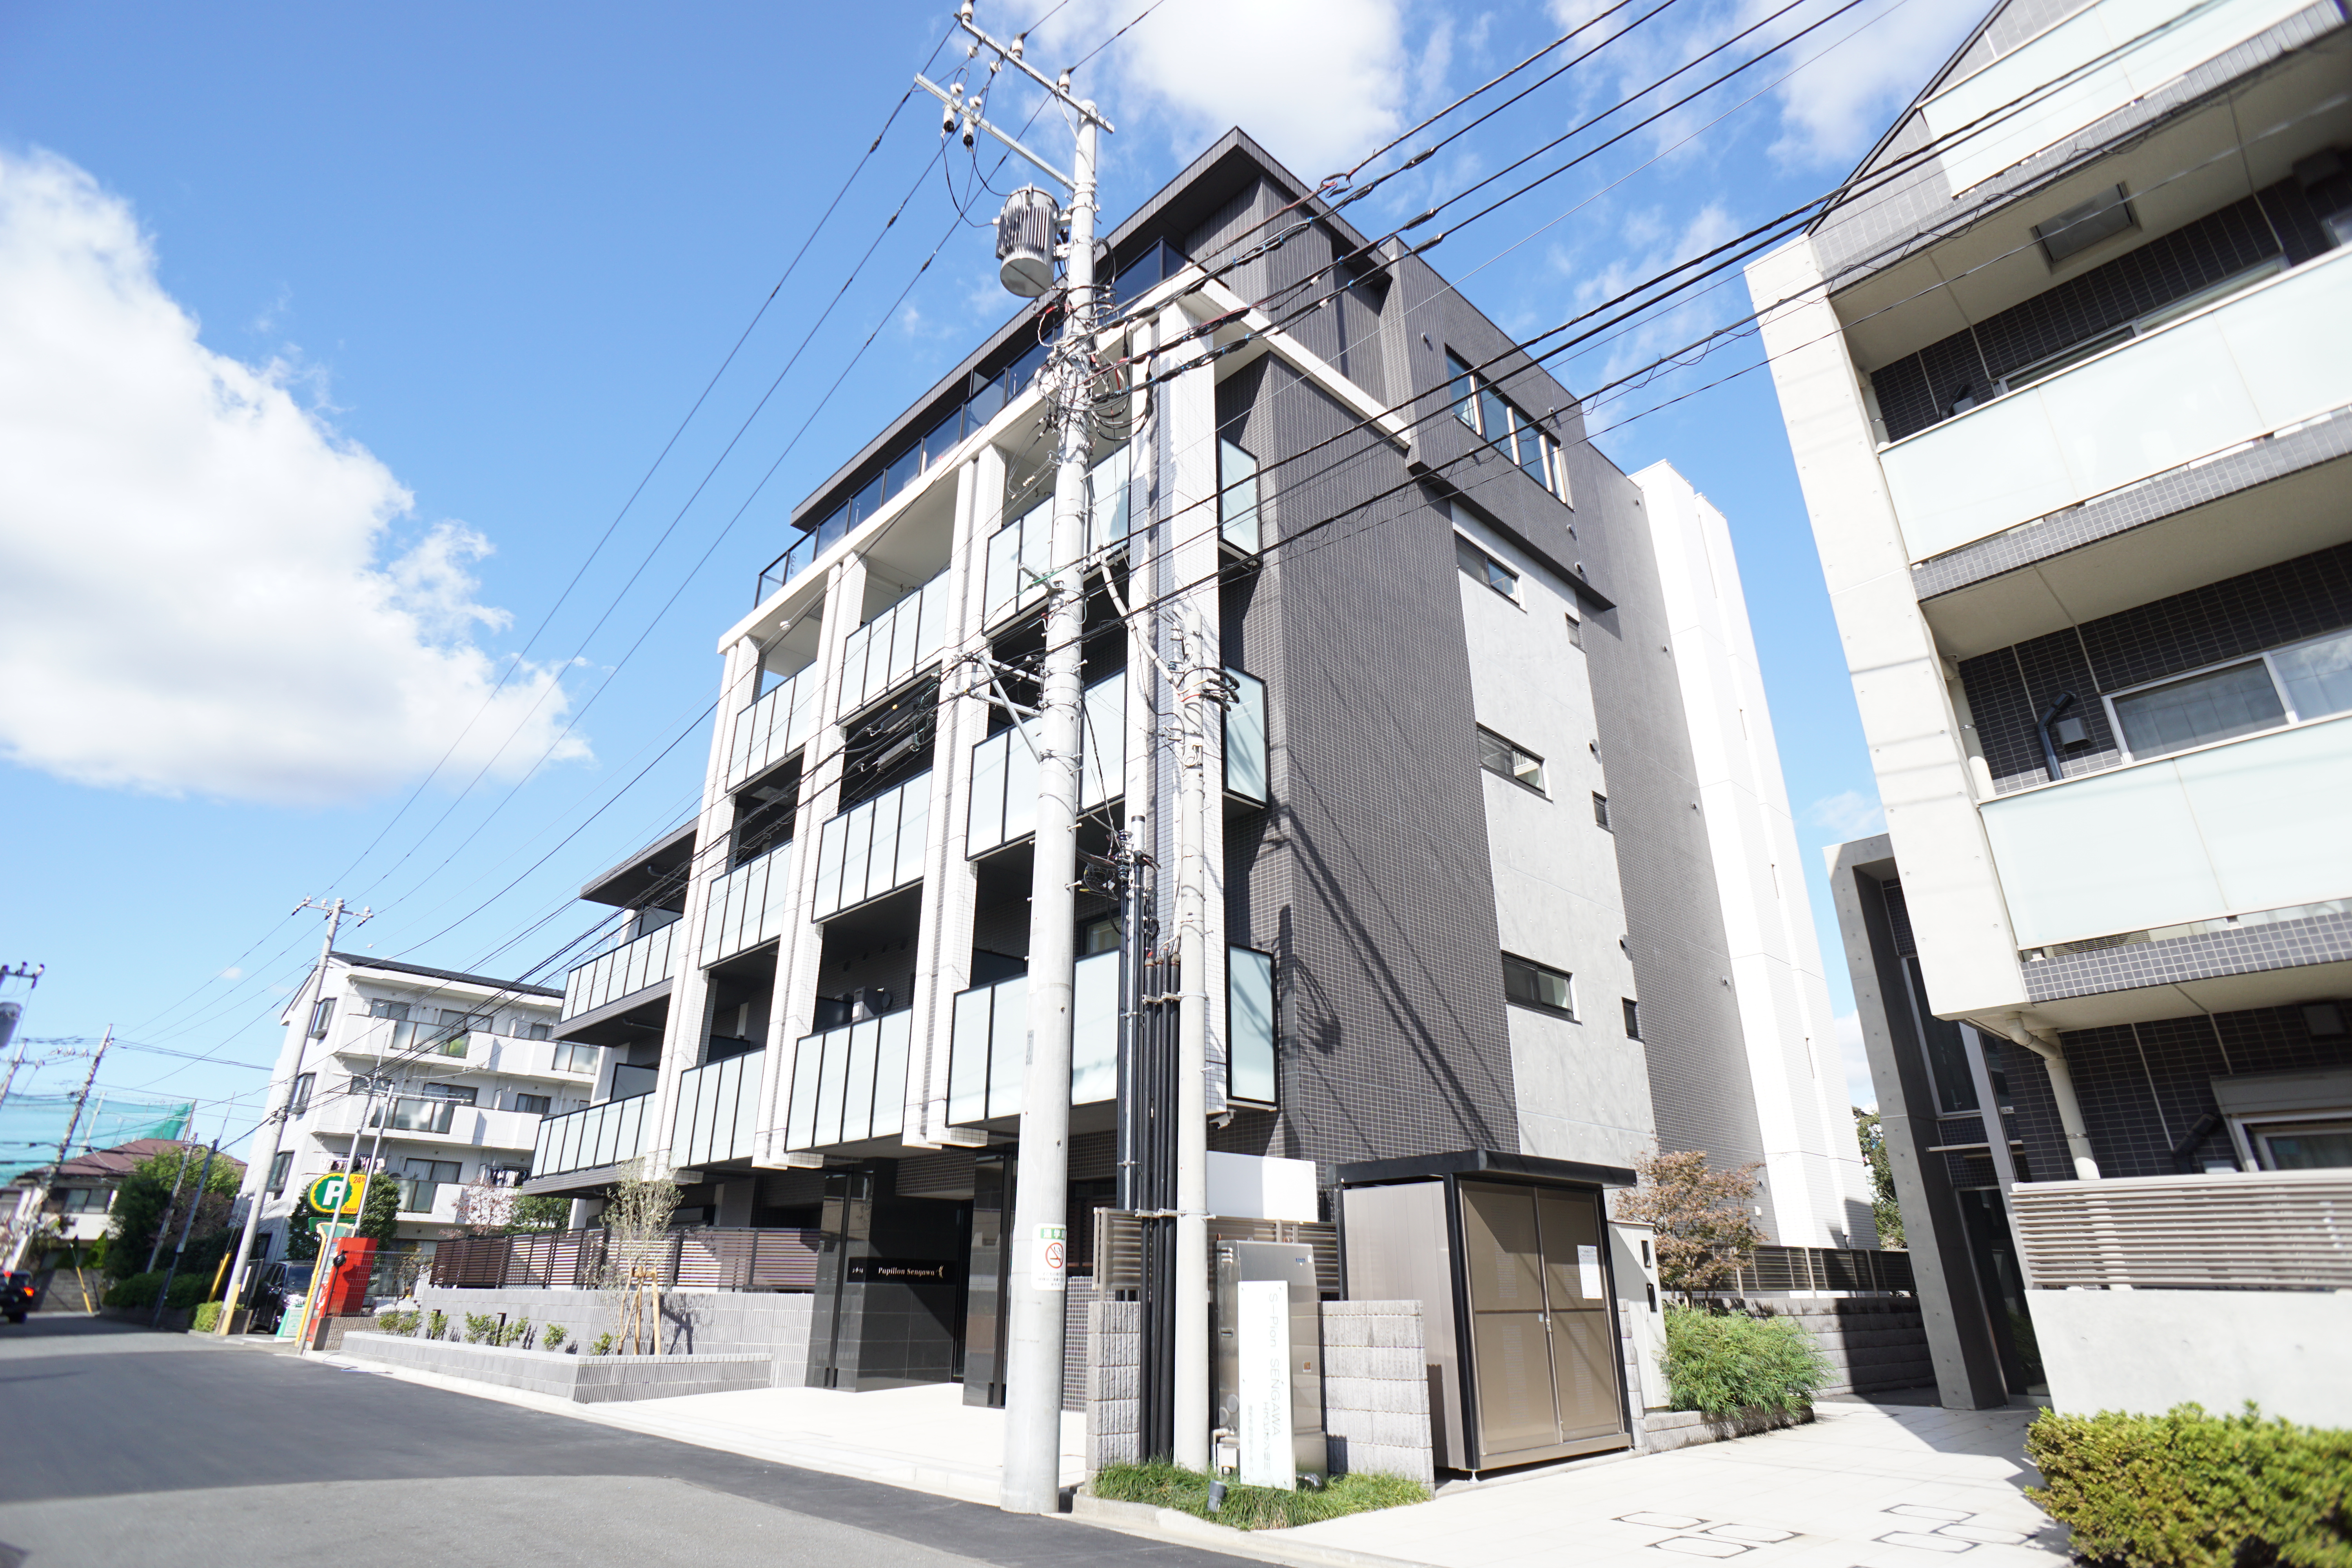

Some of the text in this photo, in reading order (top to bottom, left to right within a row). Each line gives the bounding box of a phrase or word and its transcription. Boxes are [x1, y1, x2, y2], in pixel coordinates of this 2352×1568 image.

[322, 1180, 347, 1205] P
[878, 1267, 905, 1276] Papillon
[907, 1268, 935, 1278] Sengawa
[1270, 1358, 1281, 1436] SENGAWA
